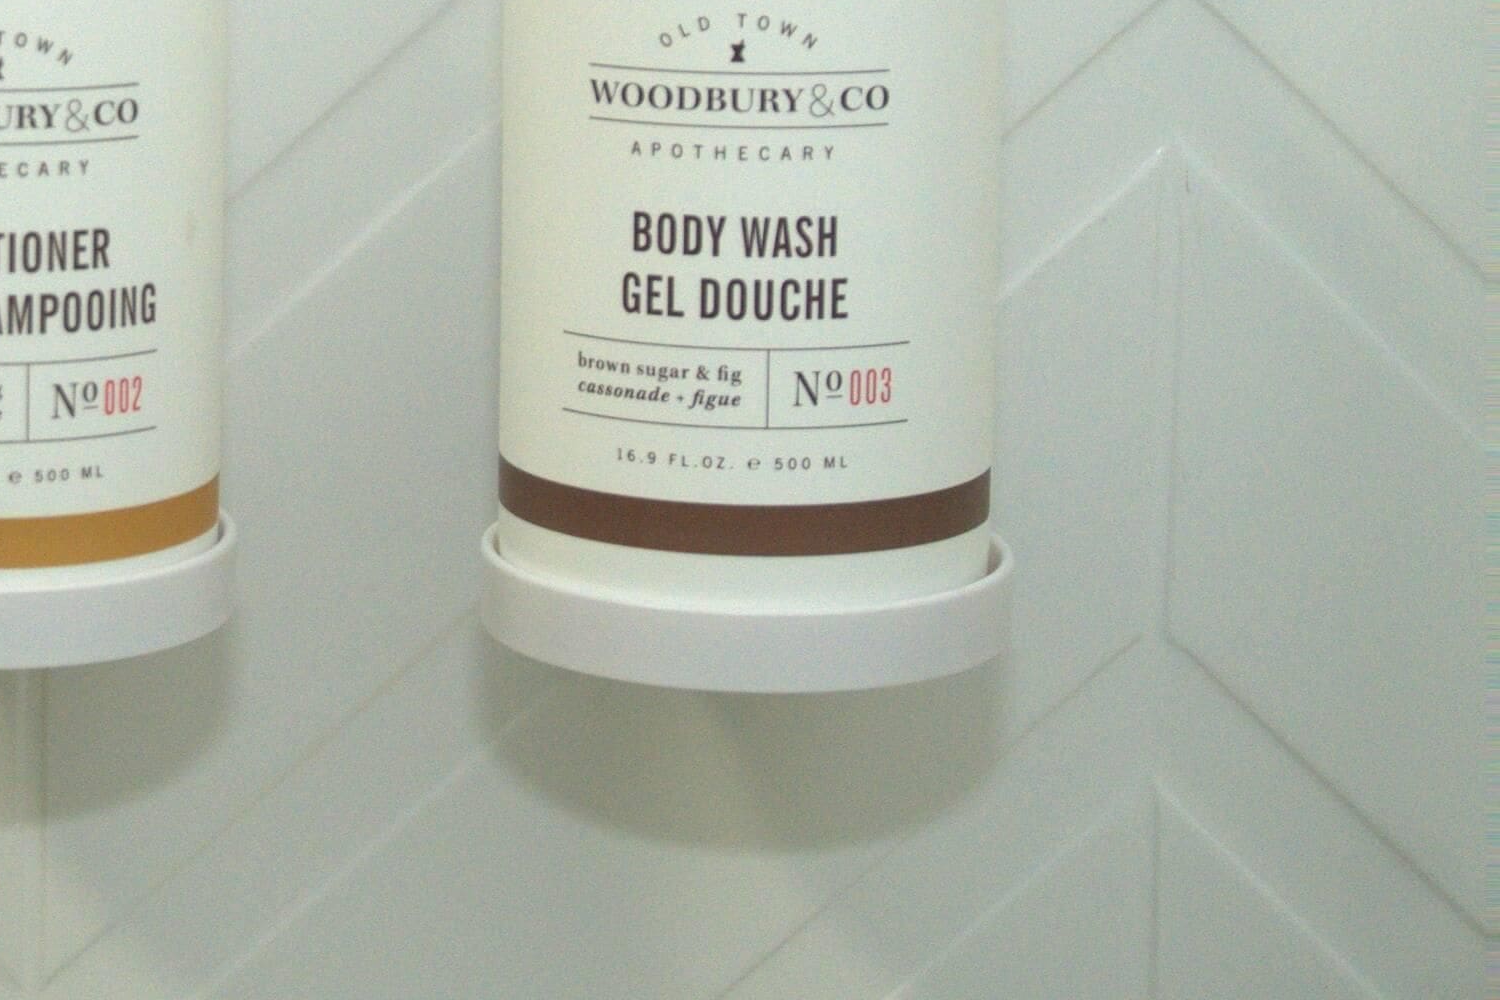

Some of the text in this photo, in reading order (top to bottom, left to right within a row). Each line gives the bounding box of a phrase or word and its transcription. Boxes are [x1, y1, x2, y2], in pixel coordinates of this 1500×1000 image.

[659, 13, 818, 49] OLD TOWN
[631, 141, 834, 161] APOTHECARY
[633, 211, 838, 258] BODY WASH
[622, 272, 848, 321] GEL DOUCHE
[577, 351, 742, 384] brown sugar & fig
[578, 379, 670, 402] cassonade
[688, 389, 741, 410] figue
[849, 367, 891, 406] 003
[35, 468, 70, 483] 500
[81, 466, 103, 479] ML
[617, 448, 656, 464] 16.9
[774, 457, 811, 470] 500
[824, 455, 848, 469] ML
